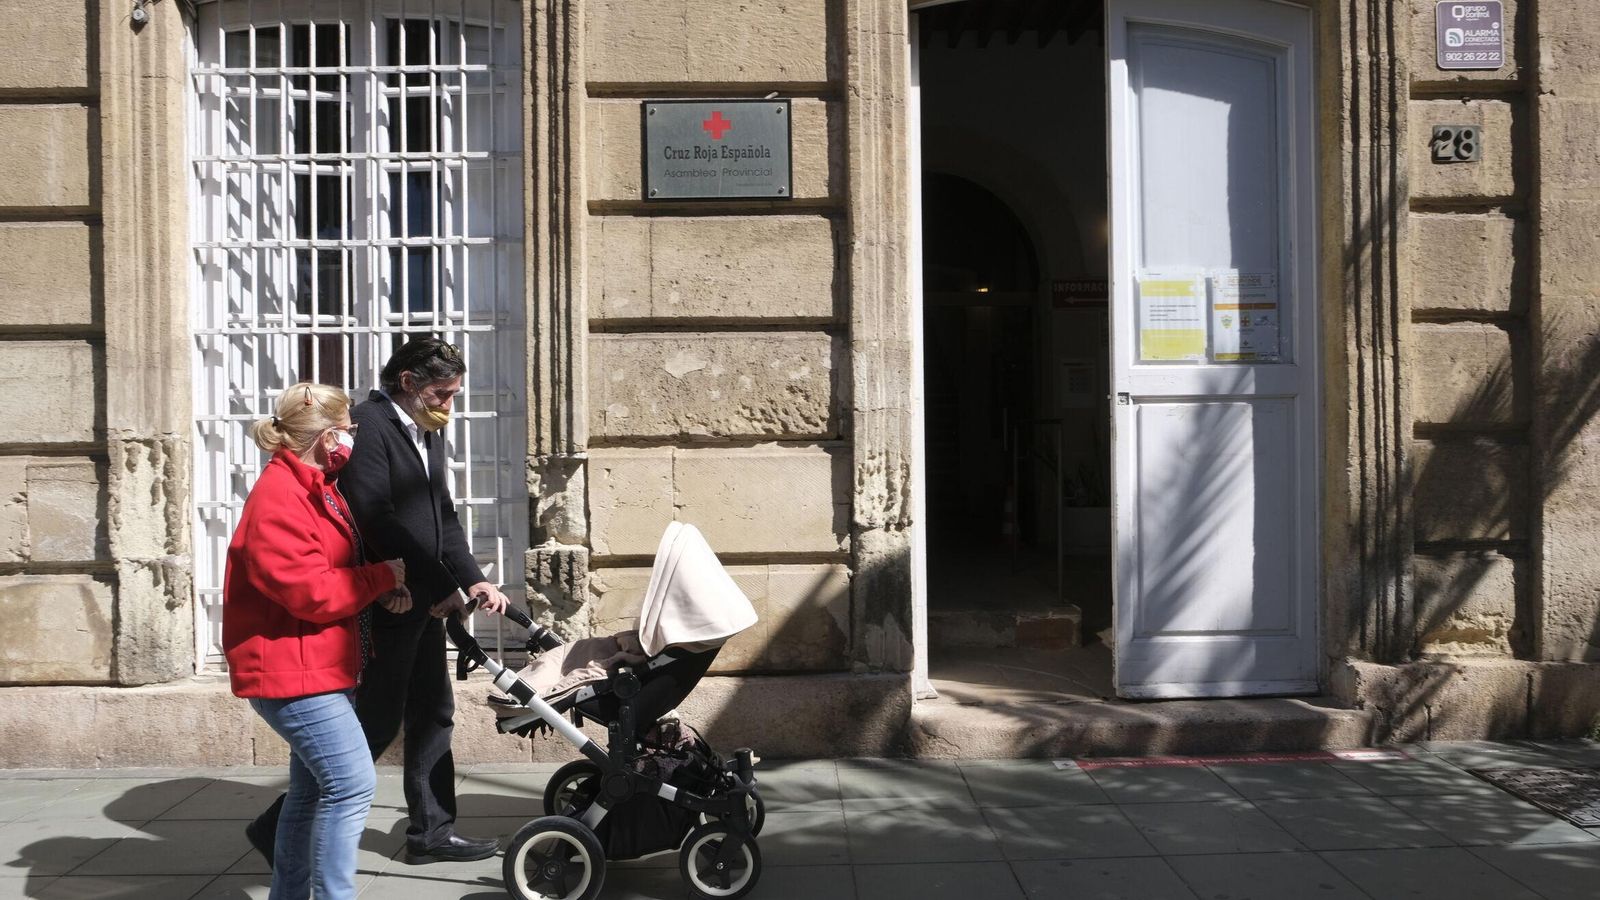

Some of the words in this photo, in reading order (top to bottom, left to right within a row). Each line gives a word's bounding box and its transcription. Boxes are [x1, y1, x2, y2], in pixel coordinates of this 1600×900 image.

[1464, 29, 1499, 37] ALARMA
[1446, 52, 1463, 60] 902
[1463, 52, 1475, 60] 26
[1476, 52, 1488, 60] 22
[1489, 52, 1500, 60] 22
[1433, 126, 1475, 161] 28
[664, 146, 690, 159] Cruz
[694, 145, 717, 162] Roja
[721, 144, 771, 162] Española
[663, 168, 717, 178] Asamblea
[722, 167, 773, 177] Provincial
